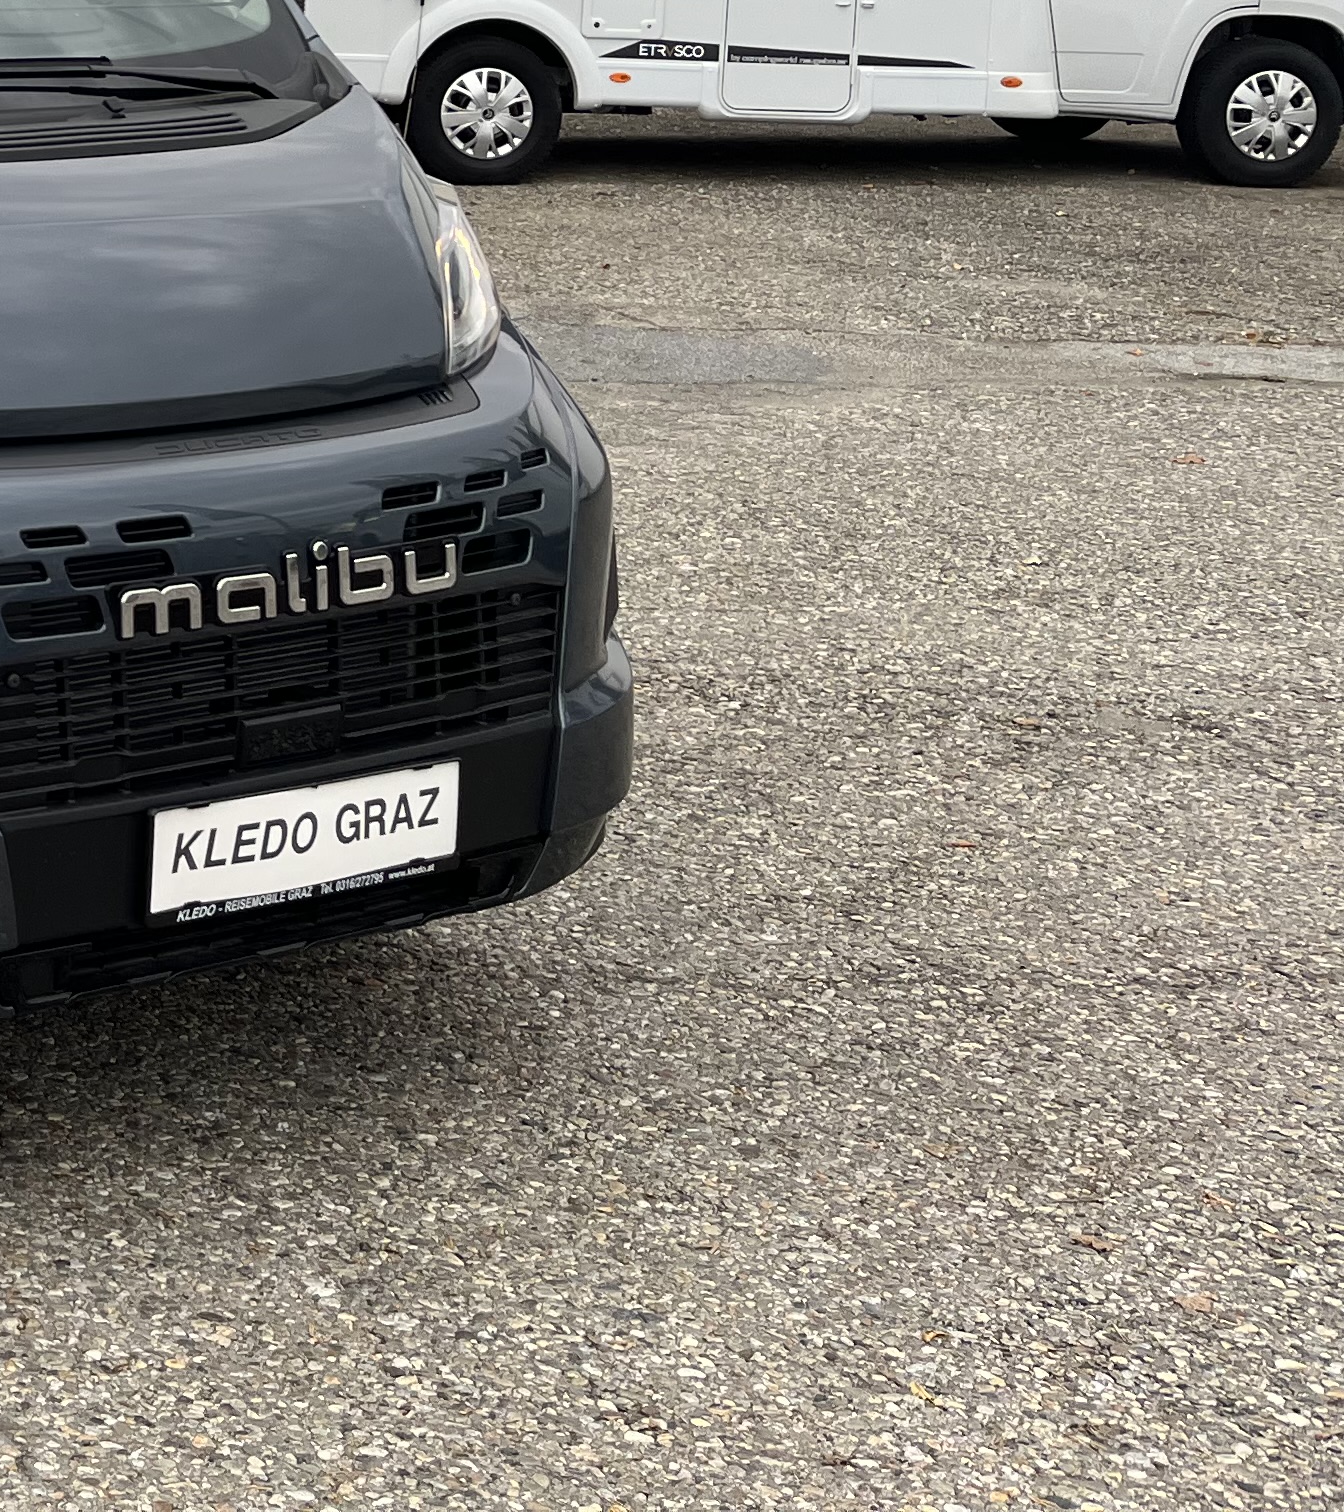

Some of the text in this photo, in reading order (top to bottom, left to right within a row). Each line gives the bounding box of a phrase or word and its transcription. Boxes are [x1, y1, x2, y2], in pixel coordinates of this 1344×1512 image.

[120, 540, 457, 639] malibu
[171, 787, 441, 874] KLEDO GRAZ
[176, 904, 217, 923] KLEDO
[224, 890, 286, 913] REISEMOBILE
[287, 886, 313, 901] GRAZ
